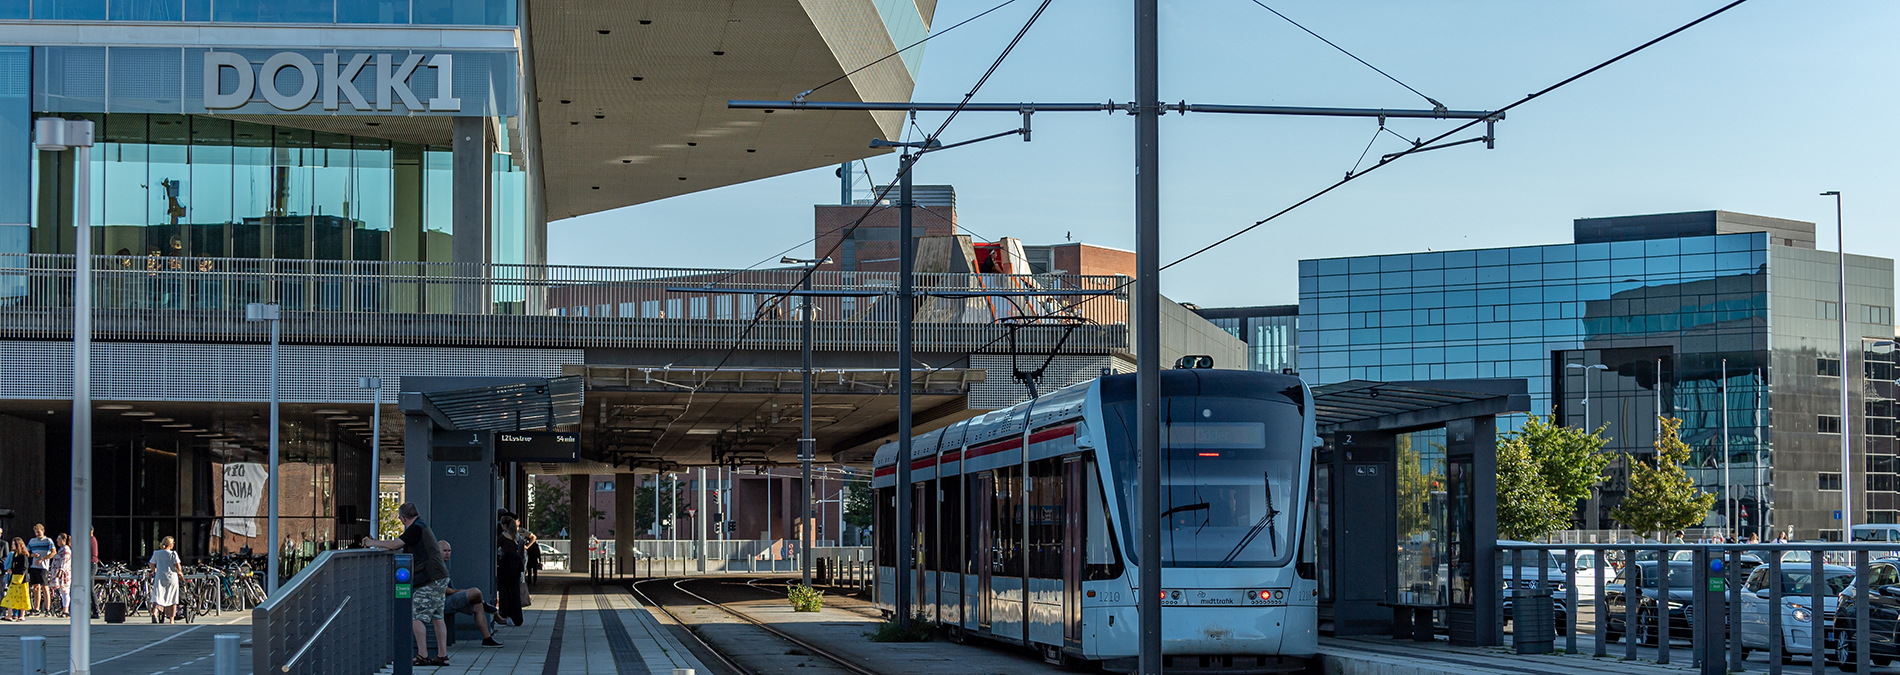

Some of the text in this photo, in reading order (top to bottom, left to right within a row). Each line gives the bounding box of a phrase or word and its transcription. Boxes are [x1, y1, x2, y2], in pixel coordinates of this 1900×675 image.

[204, 51, 461, 111] DOKK1
[473, 433, 479, 442] 1
[1346, 434, 1352, 443] 2
[1099, 591, 1120, 602] 1210
